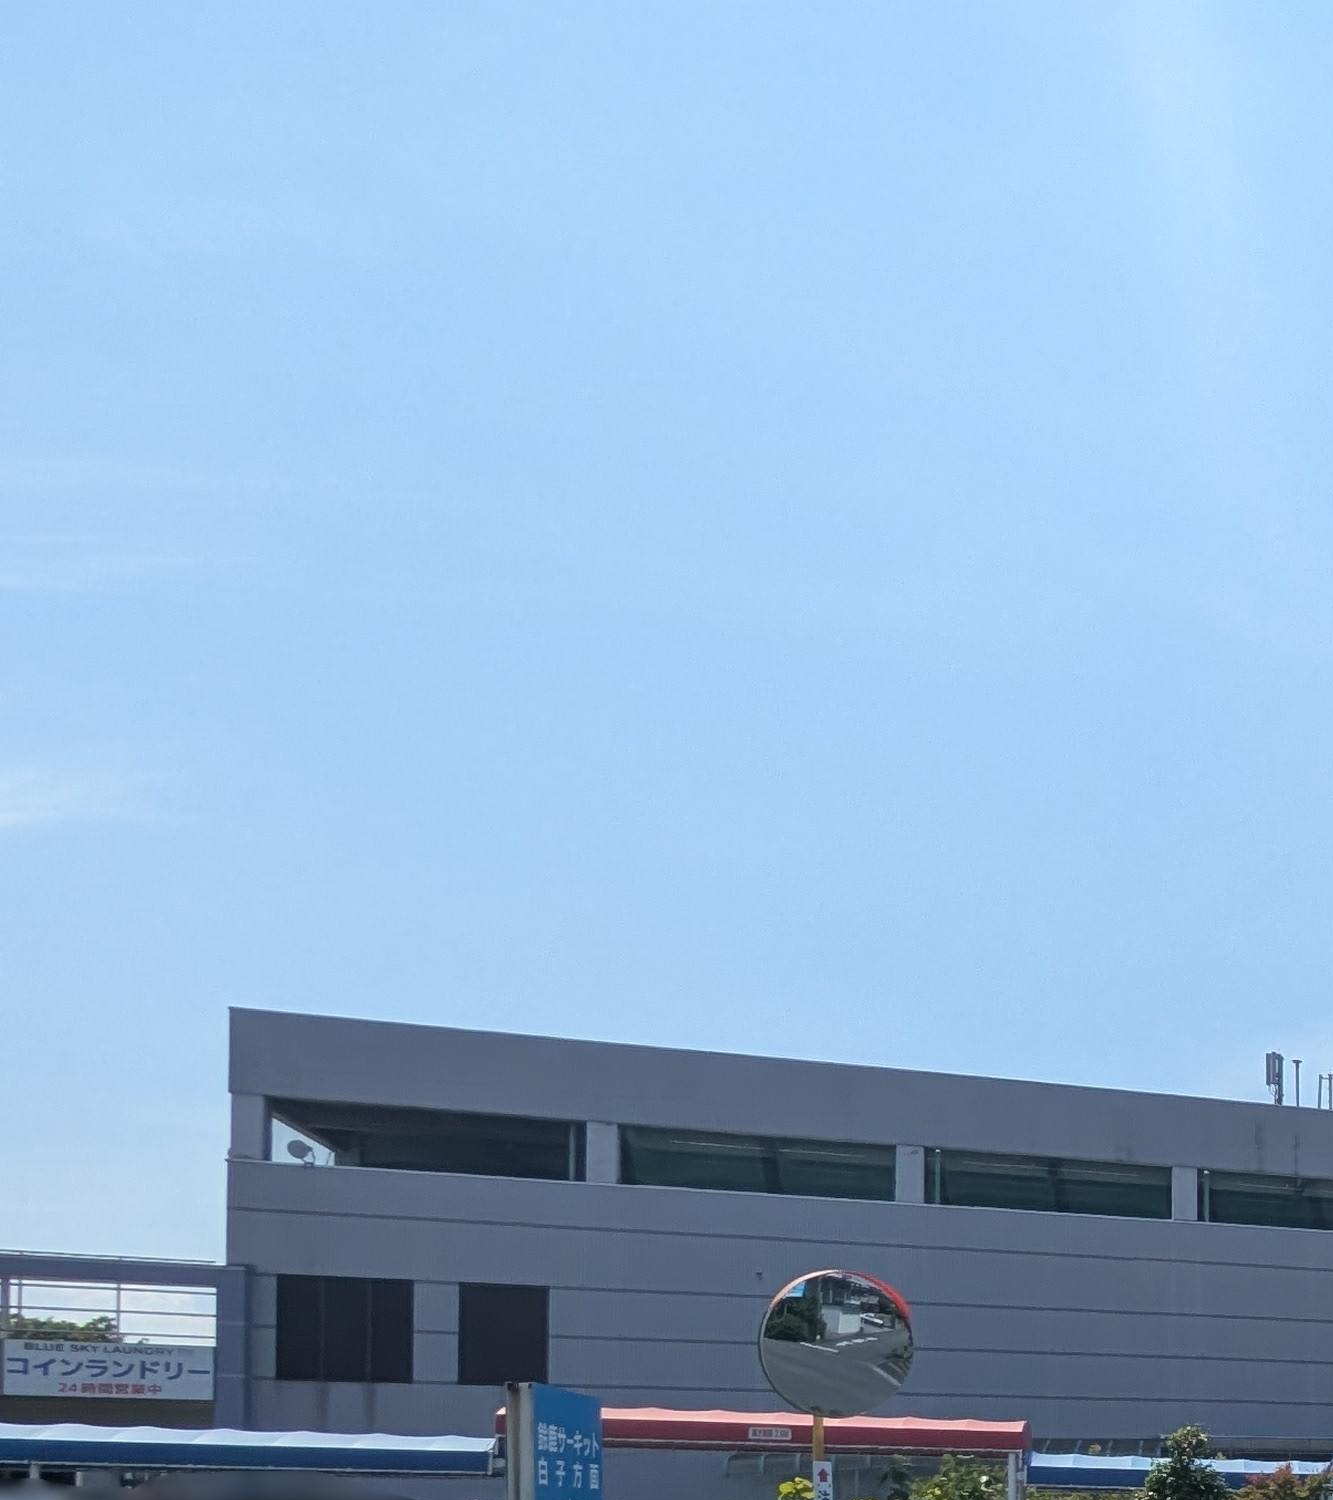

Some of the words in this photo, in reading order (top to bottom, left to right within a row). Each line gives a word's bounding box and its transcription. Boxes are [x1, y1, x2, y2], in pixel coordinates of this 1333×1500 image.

[24, 1341, 65, 1351] BLUE
[70, 1344, 99, 1354] SKY
[104, 1346, 180, 1356] LAUNDRY
[6, 1357, 211, 1380] コインランドリー
[58, 1382, 163, 1396] 24時間営業中
[537, 1422, 600, 1458] 鈴鹿サーキット
[537, 1455, 600, 1490] 白子方面
